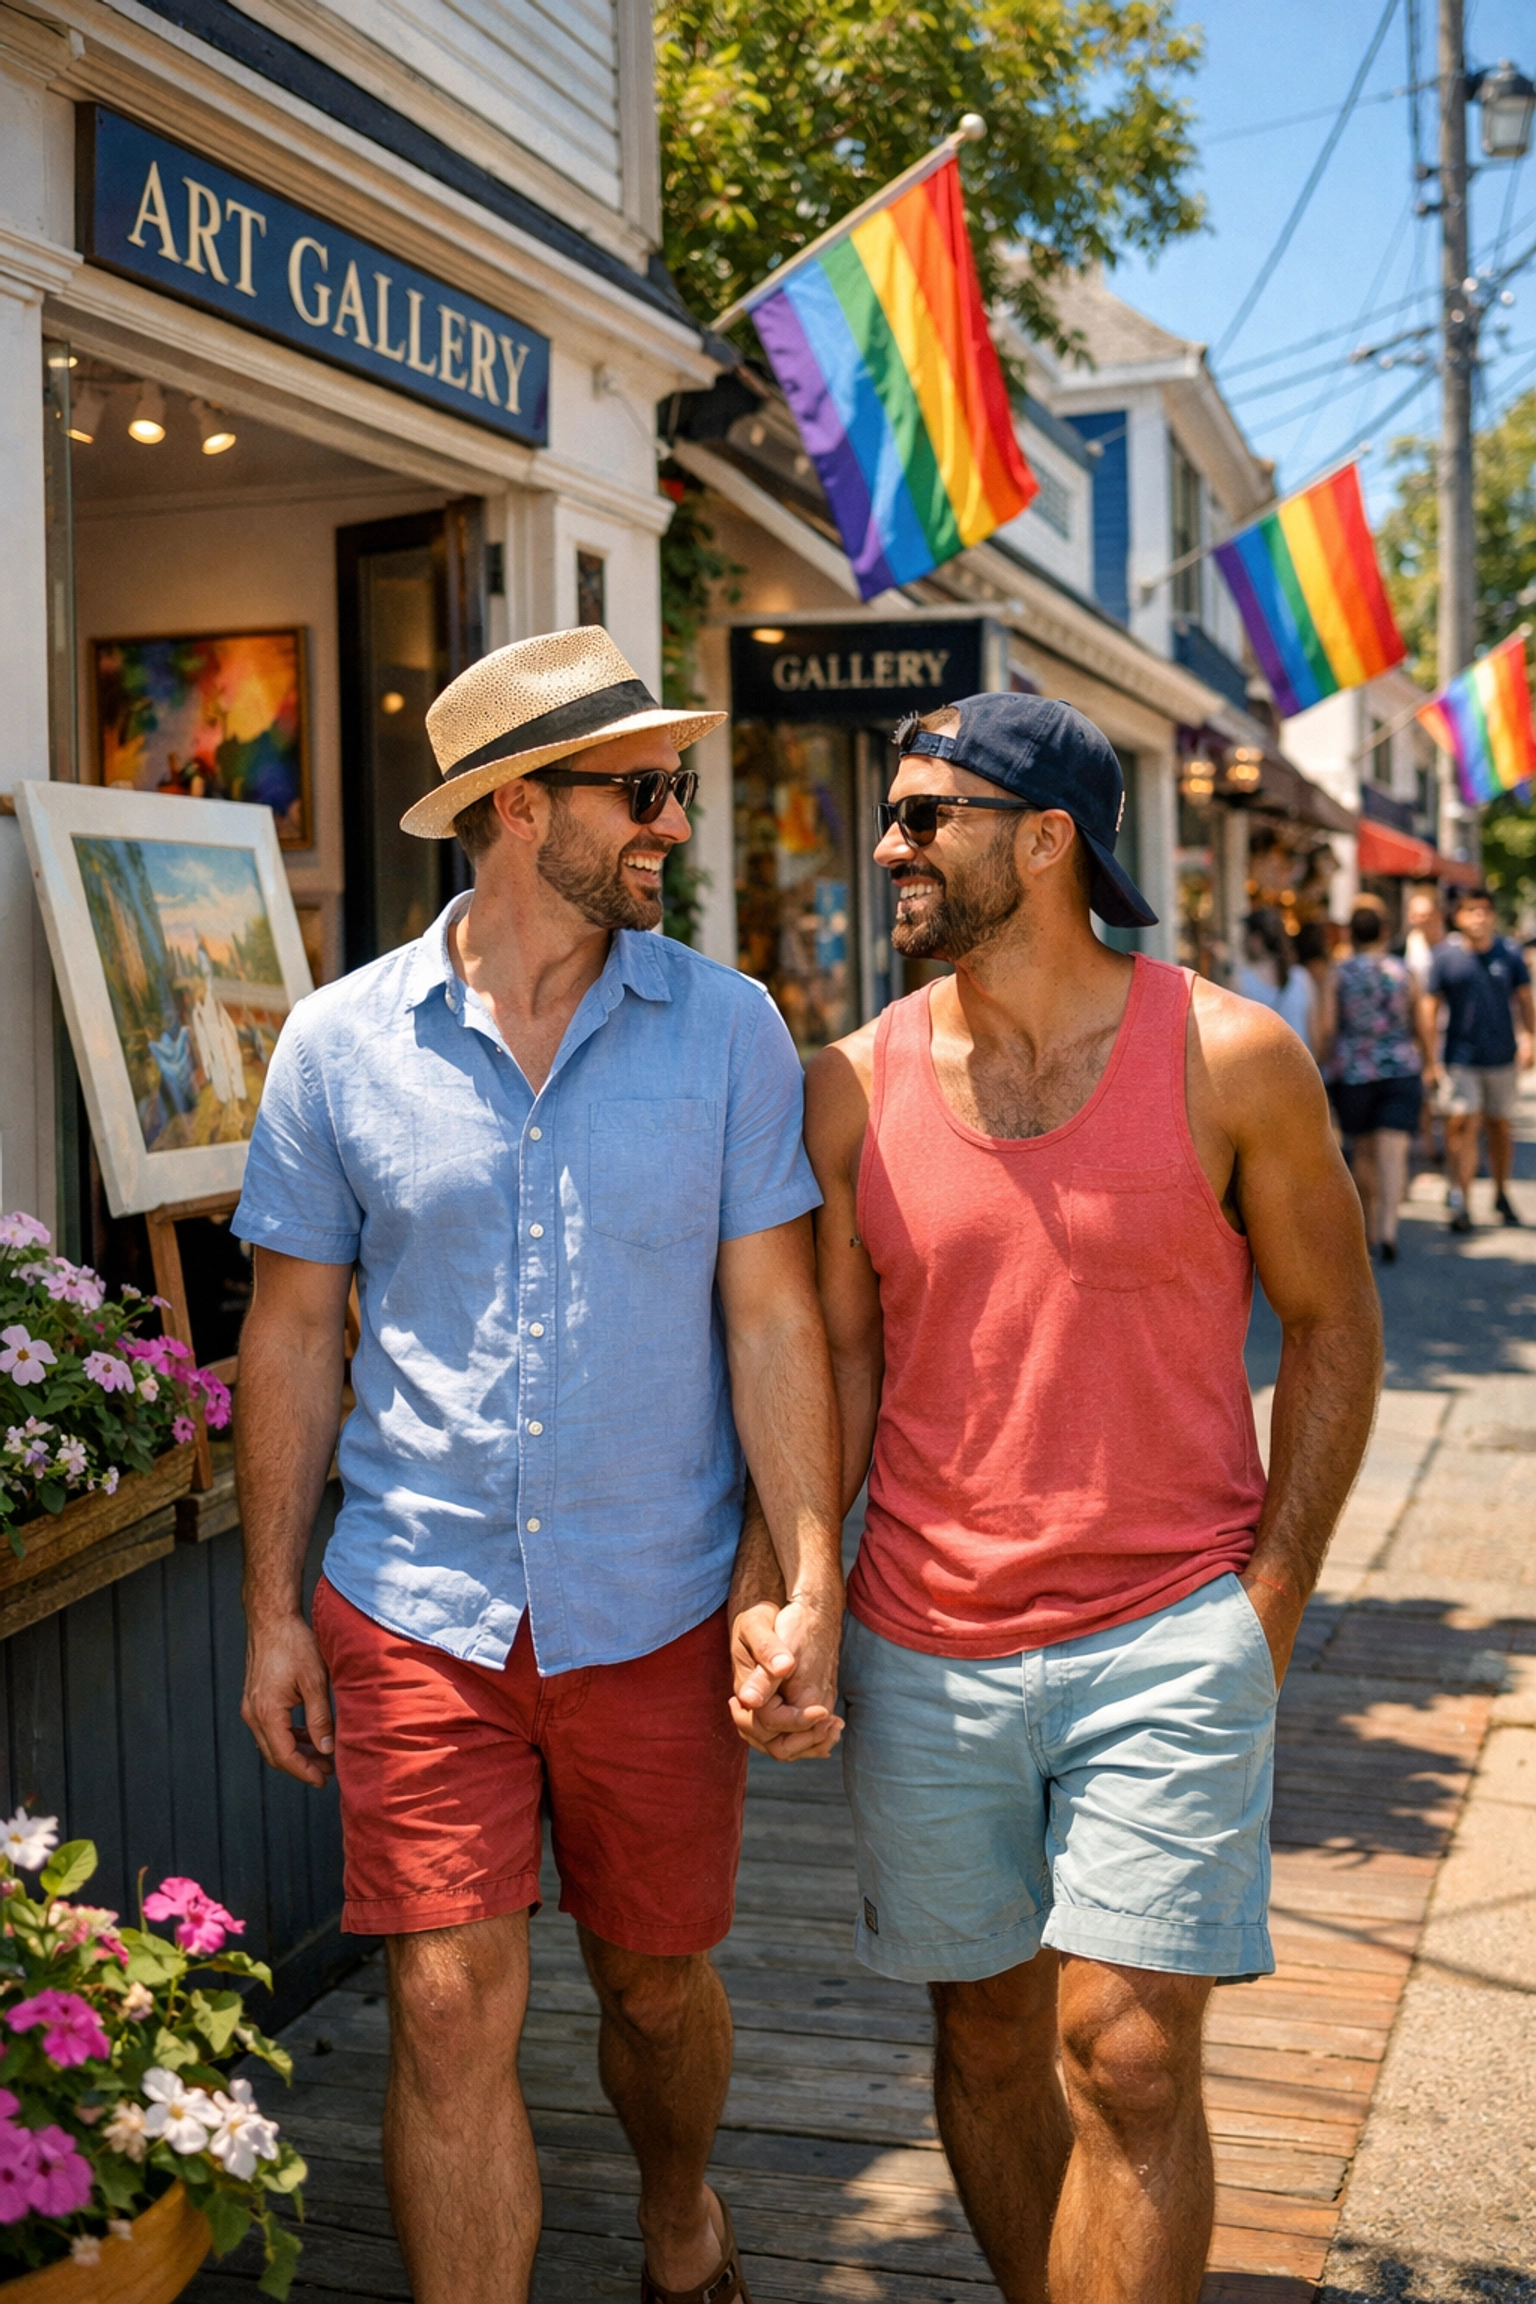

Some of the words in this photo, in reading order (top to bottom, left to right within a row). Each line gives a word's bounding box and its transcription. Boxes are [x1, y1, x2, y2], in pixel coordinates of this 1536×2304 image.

[127, 160, 267, 298] ART
[287, 236, 531, 415] GALLERY
[772, 650, 949, 691] GALLERY
